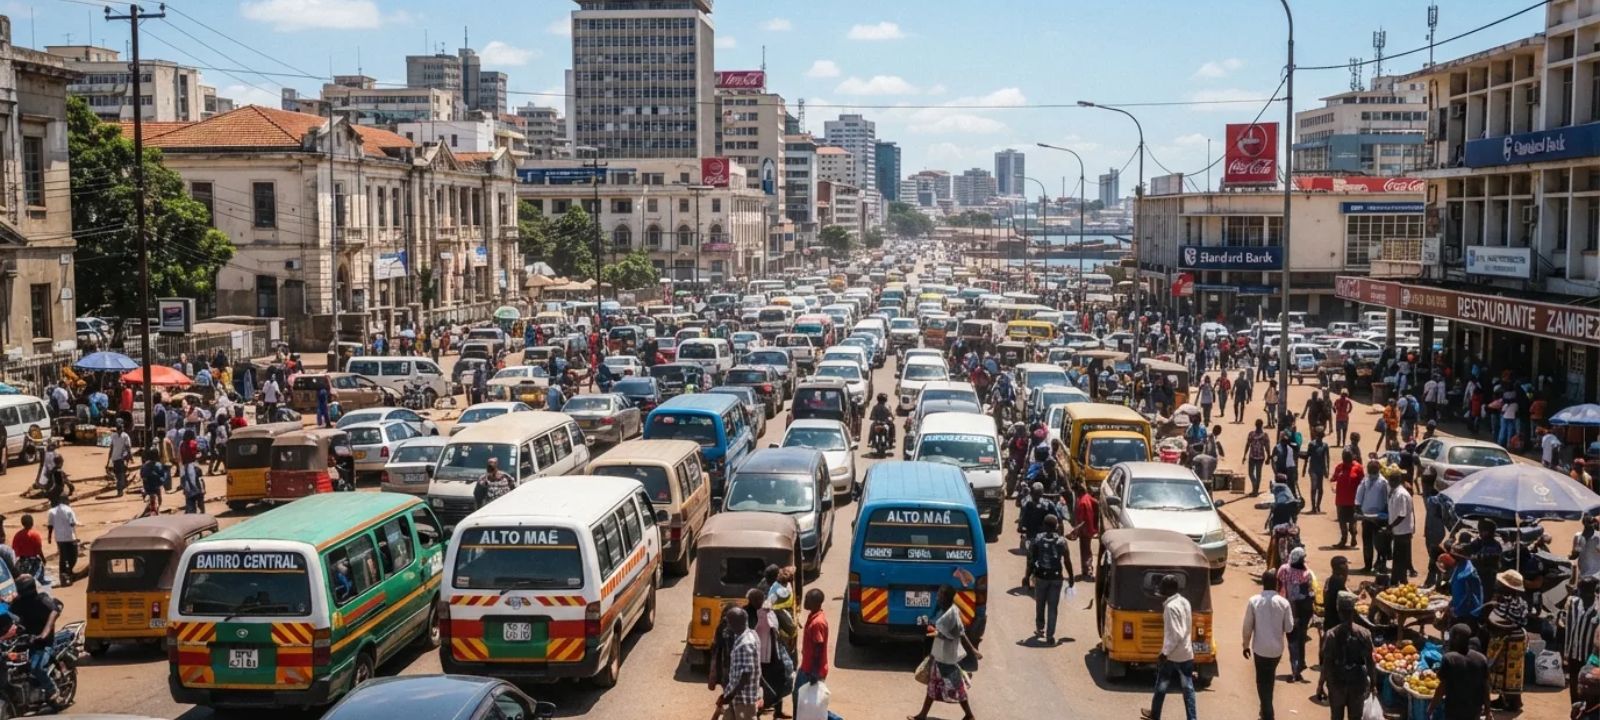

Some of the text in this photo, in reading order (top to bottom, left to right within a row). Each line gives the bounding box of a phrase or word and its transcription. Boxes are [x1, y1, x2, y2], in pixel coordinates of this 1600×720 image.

[1245, 251, 1273, 263] Bank
[1457, 296, 1536, 331] RESTAURANTE
[886, 510, 921, 523] ALTO
[479, 530, 521, 545] ALTO
[243, 554, 298, 569] CENTRAL
